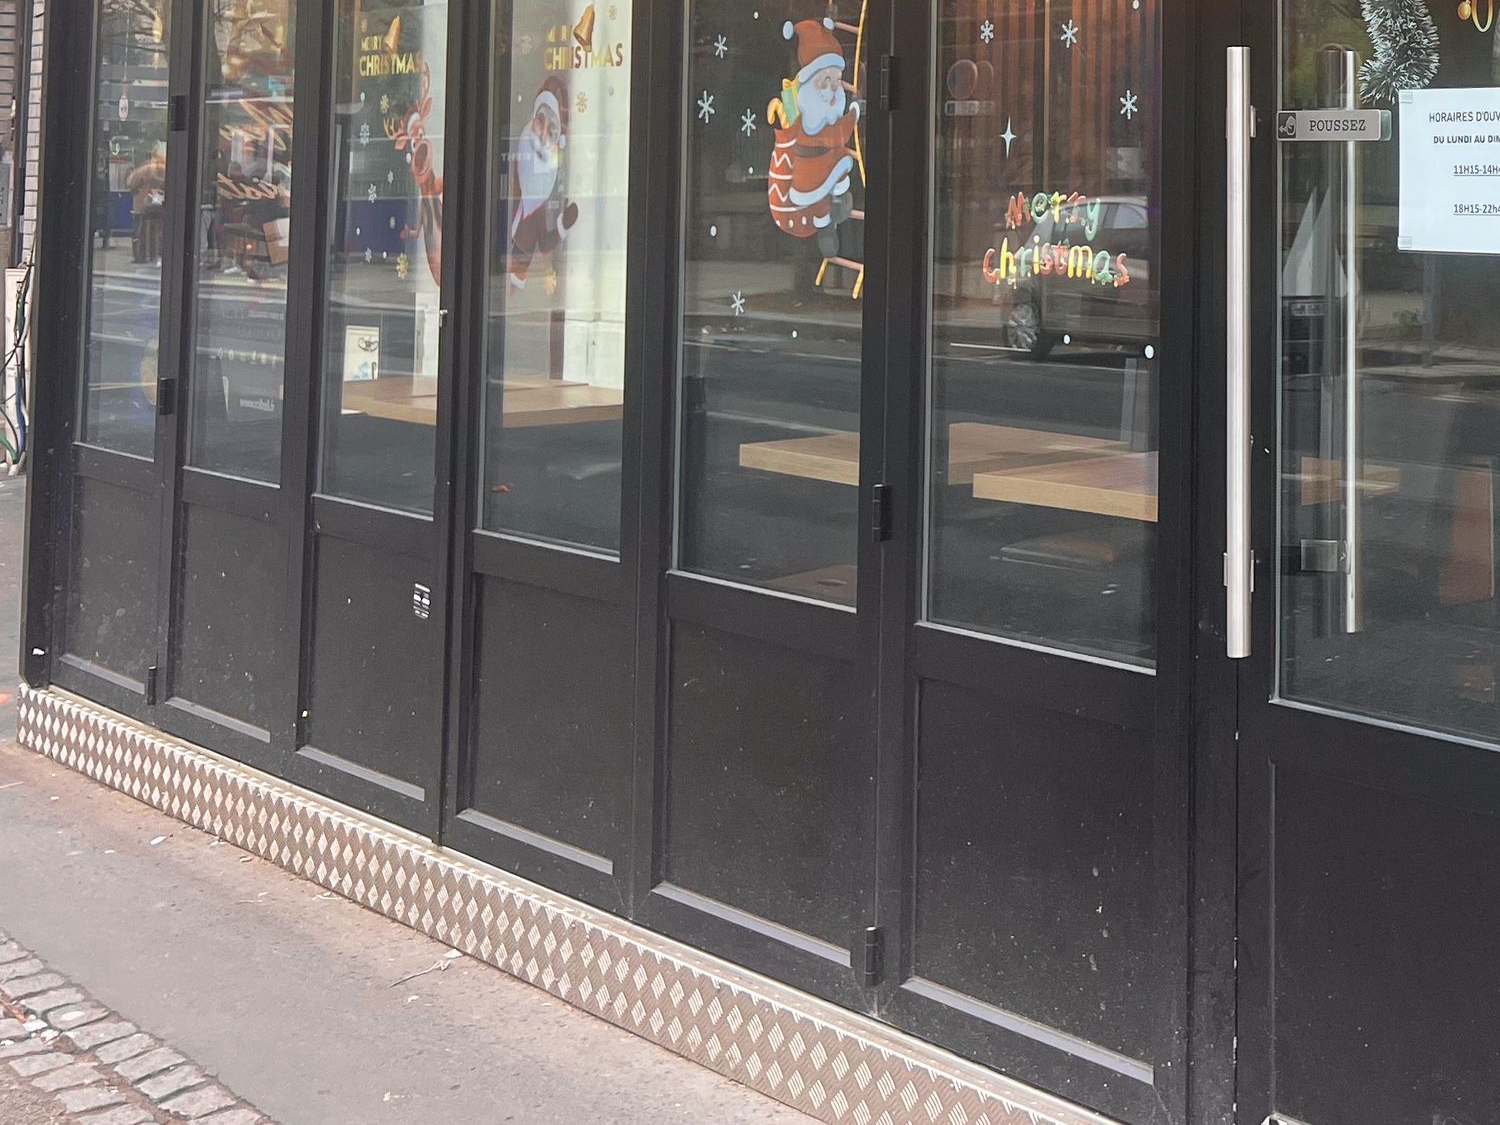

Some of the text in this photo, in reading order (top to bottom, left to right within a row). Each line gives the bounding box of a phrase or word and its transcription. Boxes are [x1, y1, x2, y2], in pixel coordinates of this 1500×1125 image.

[1428, 111, 1474, 123] HORAIRES
[1308, 119, 1367, 132] POUSSEZ
[1433, 135, 1445, 144] DU
[1447, 135, 1472, 144] LUNDI
[1474, 134, 1485, 143] AU
